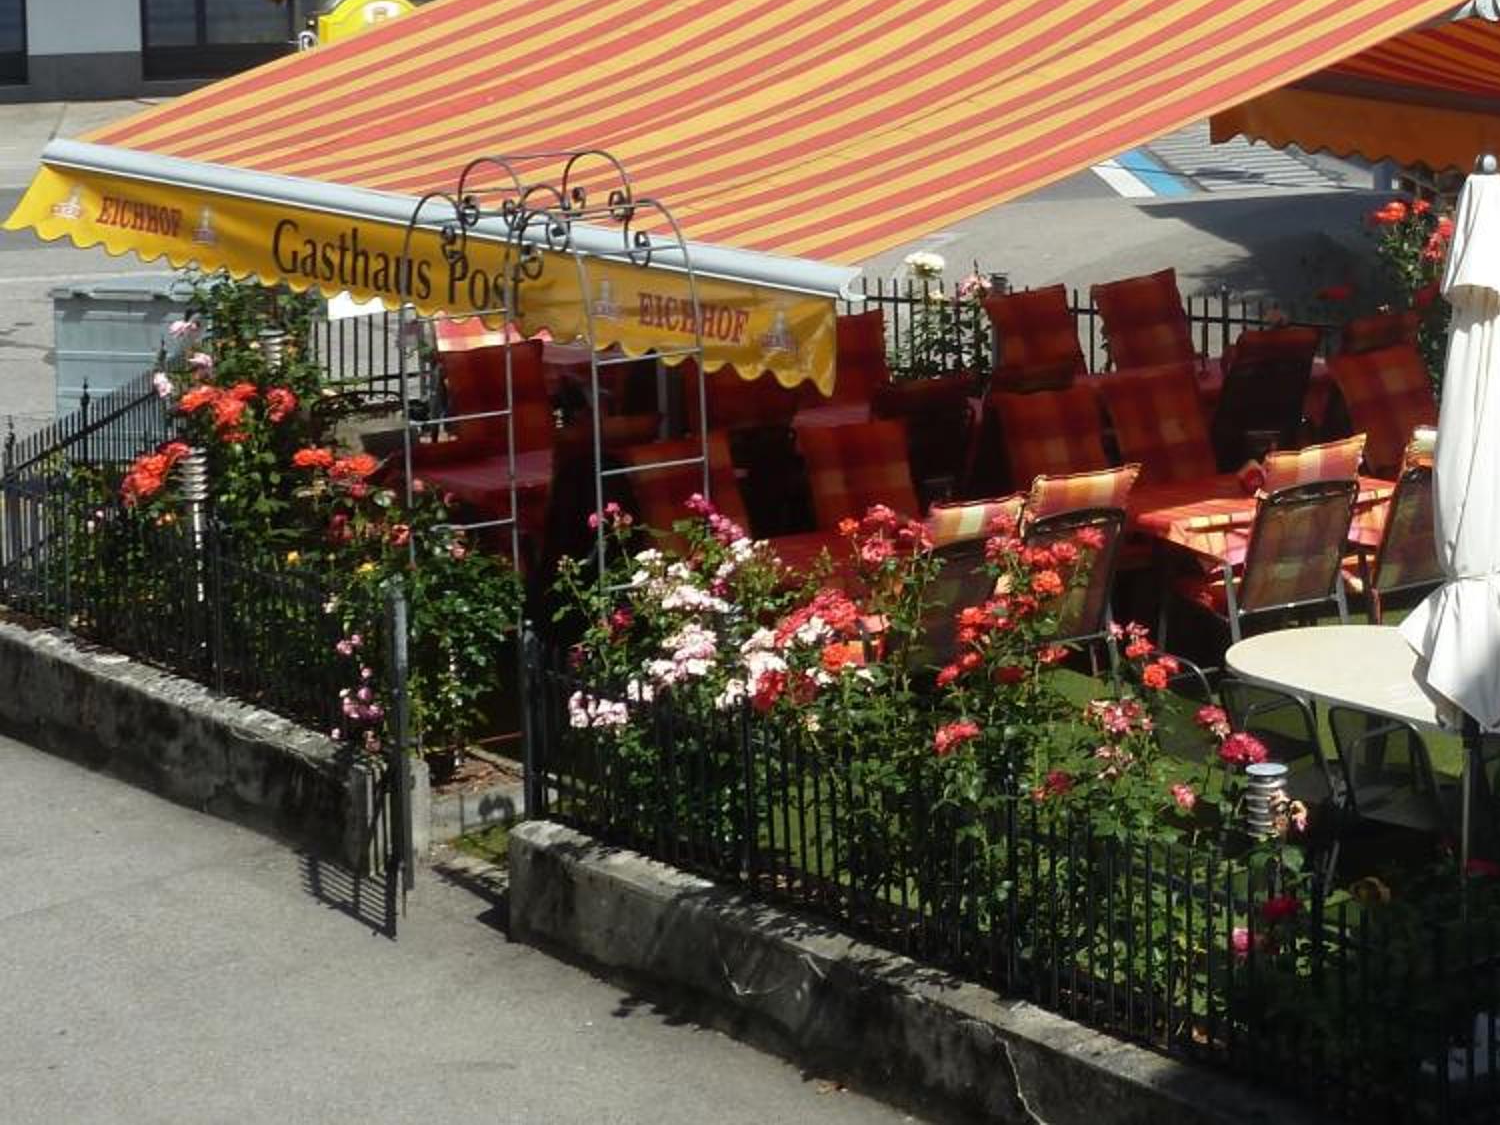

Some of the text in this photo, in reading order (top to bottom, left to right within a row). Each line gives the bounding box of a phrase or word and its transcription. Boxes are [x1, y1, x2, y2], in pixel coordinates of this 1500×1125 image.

[96, 196, 183, 238] EICHHOF
[272, 218, 432, 300] Gasthaus
[638, 291, 750, 344] EICHHOF
